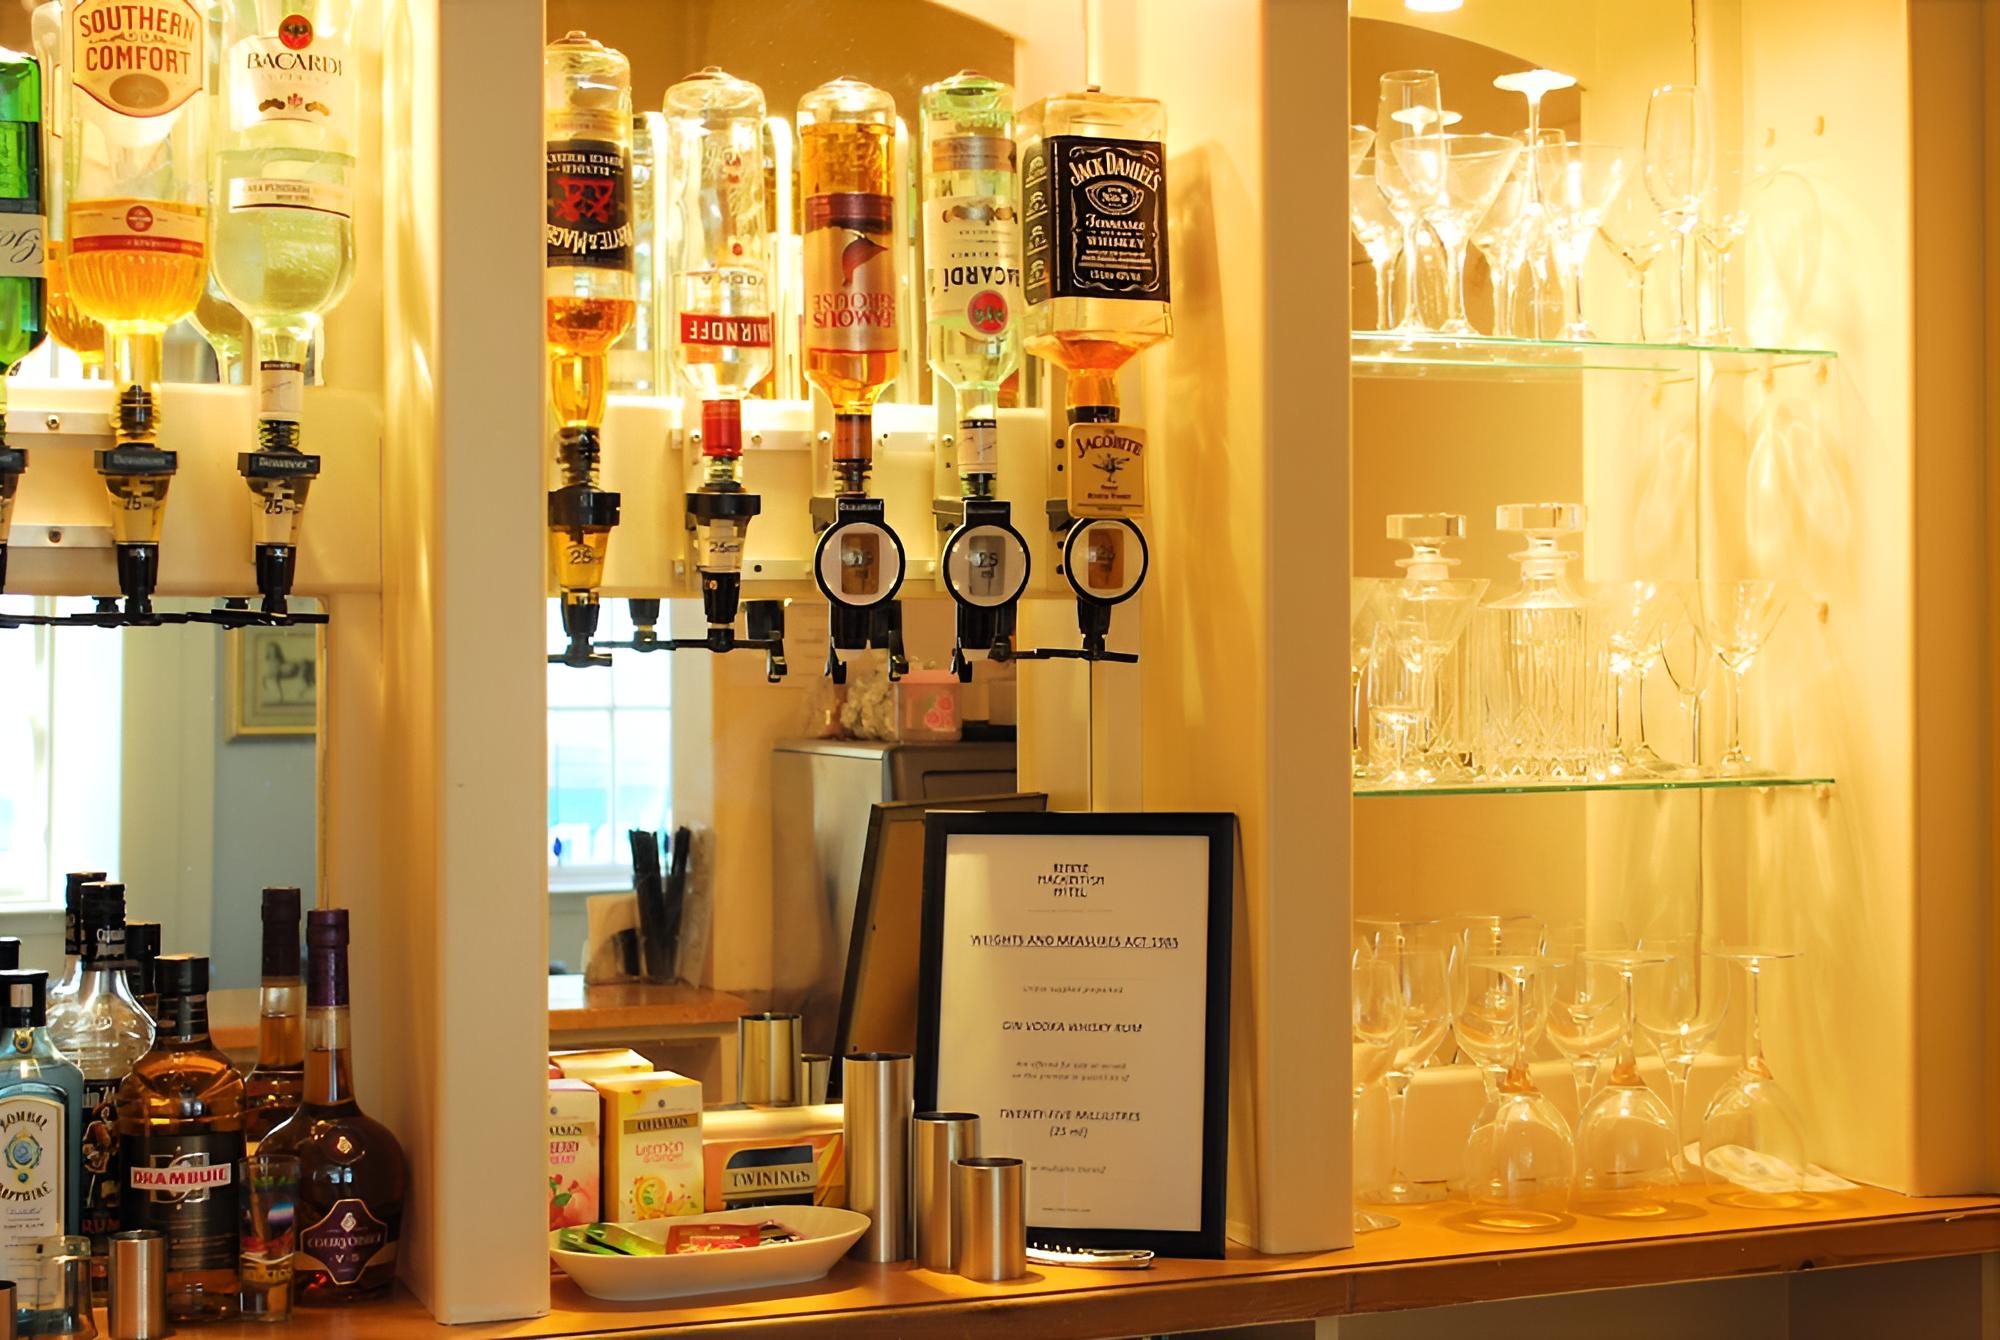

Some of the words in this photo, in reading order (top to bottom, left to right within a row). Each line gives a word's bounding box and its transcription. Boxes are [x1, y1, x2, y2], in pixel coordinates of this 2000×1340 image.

[79, 6, 196, 39] SOUTHERN
[86, 46, 191, 75] COMFORT
[1069, 157, 1106, 187] JACK
[1105, 151, 1162, 193] DANIEL'S
[812, 309, 892, 329] FAMOUS
[690, 320, 770, 343] MIRNOFF
[1076, 434, 1143, 459] JACOBITE
[1027, 935, 1055, 947] AND
[1124, 936, 1146, 948] ACT
[1002, 1020, 1023, 1031] GIN
[133, 1167, 226, 1185] DRAMBUIE
[733, 1169, 811, 1188] TWININGS
